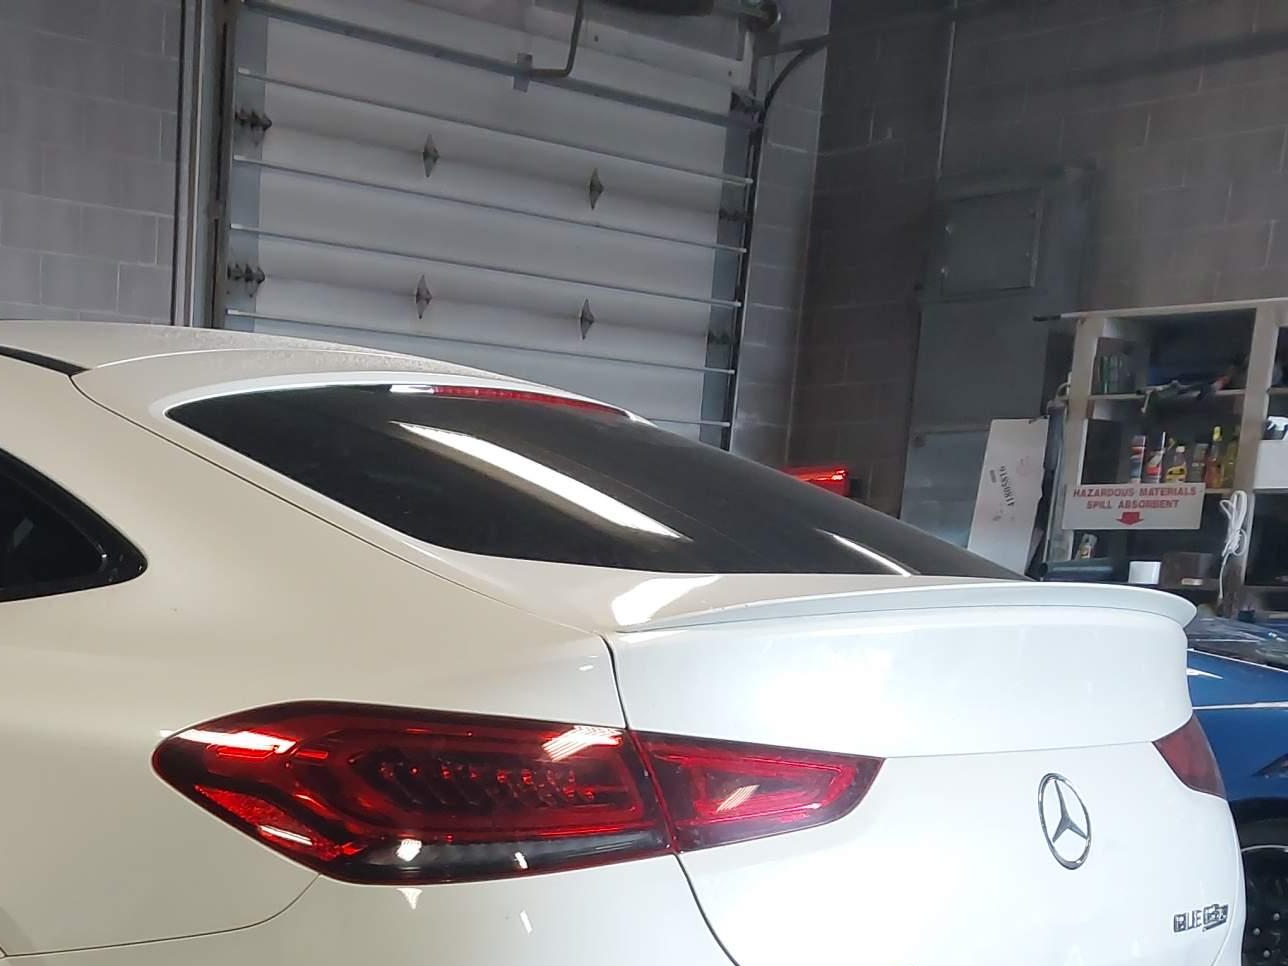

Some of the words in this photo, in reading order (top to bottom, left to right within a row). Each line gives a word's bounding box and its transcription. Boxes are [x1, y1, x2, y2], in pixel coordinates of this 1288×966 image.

[1073, 488, 1134, 497] HAZARDOUS
[1139, 486, 1197, 497] MATERIALS
[1086, 500, 1112, 510] SPILL
[1118, 499, 1180, 510] ABSORBENT
